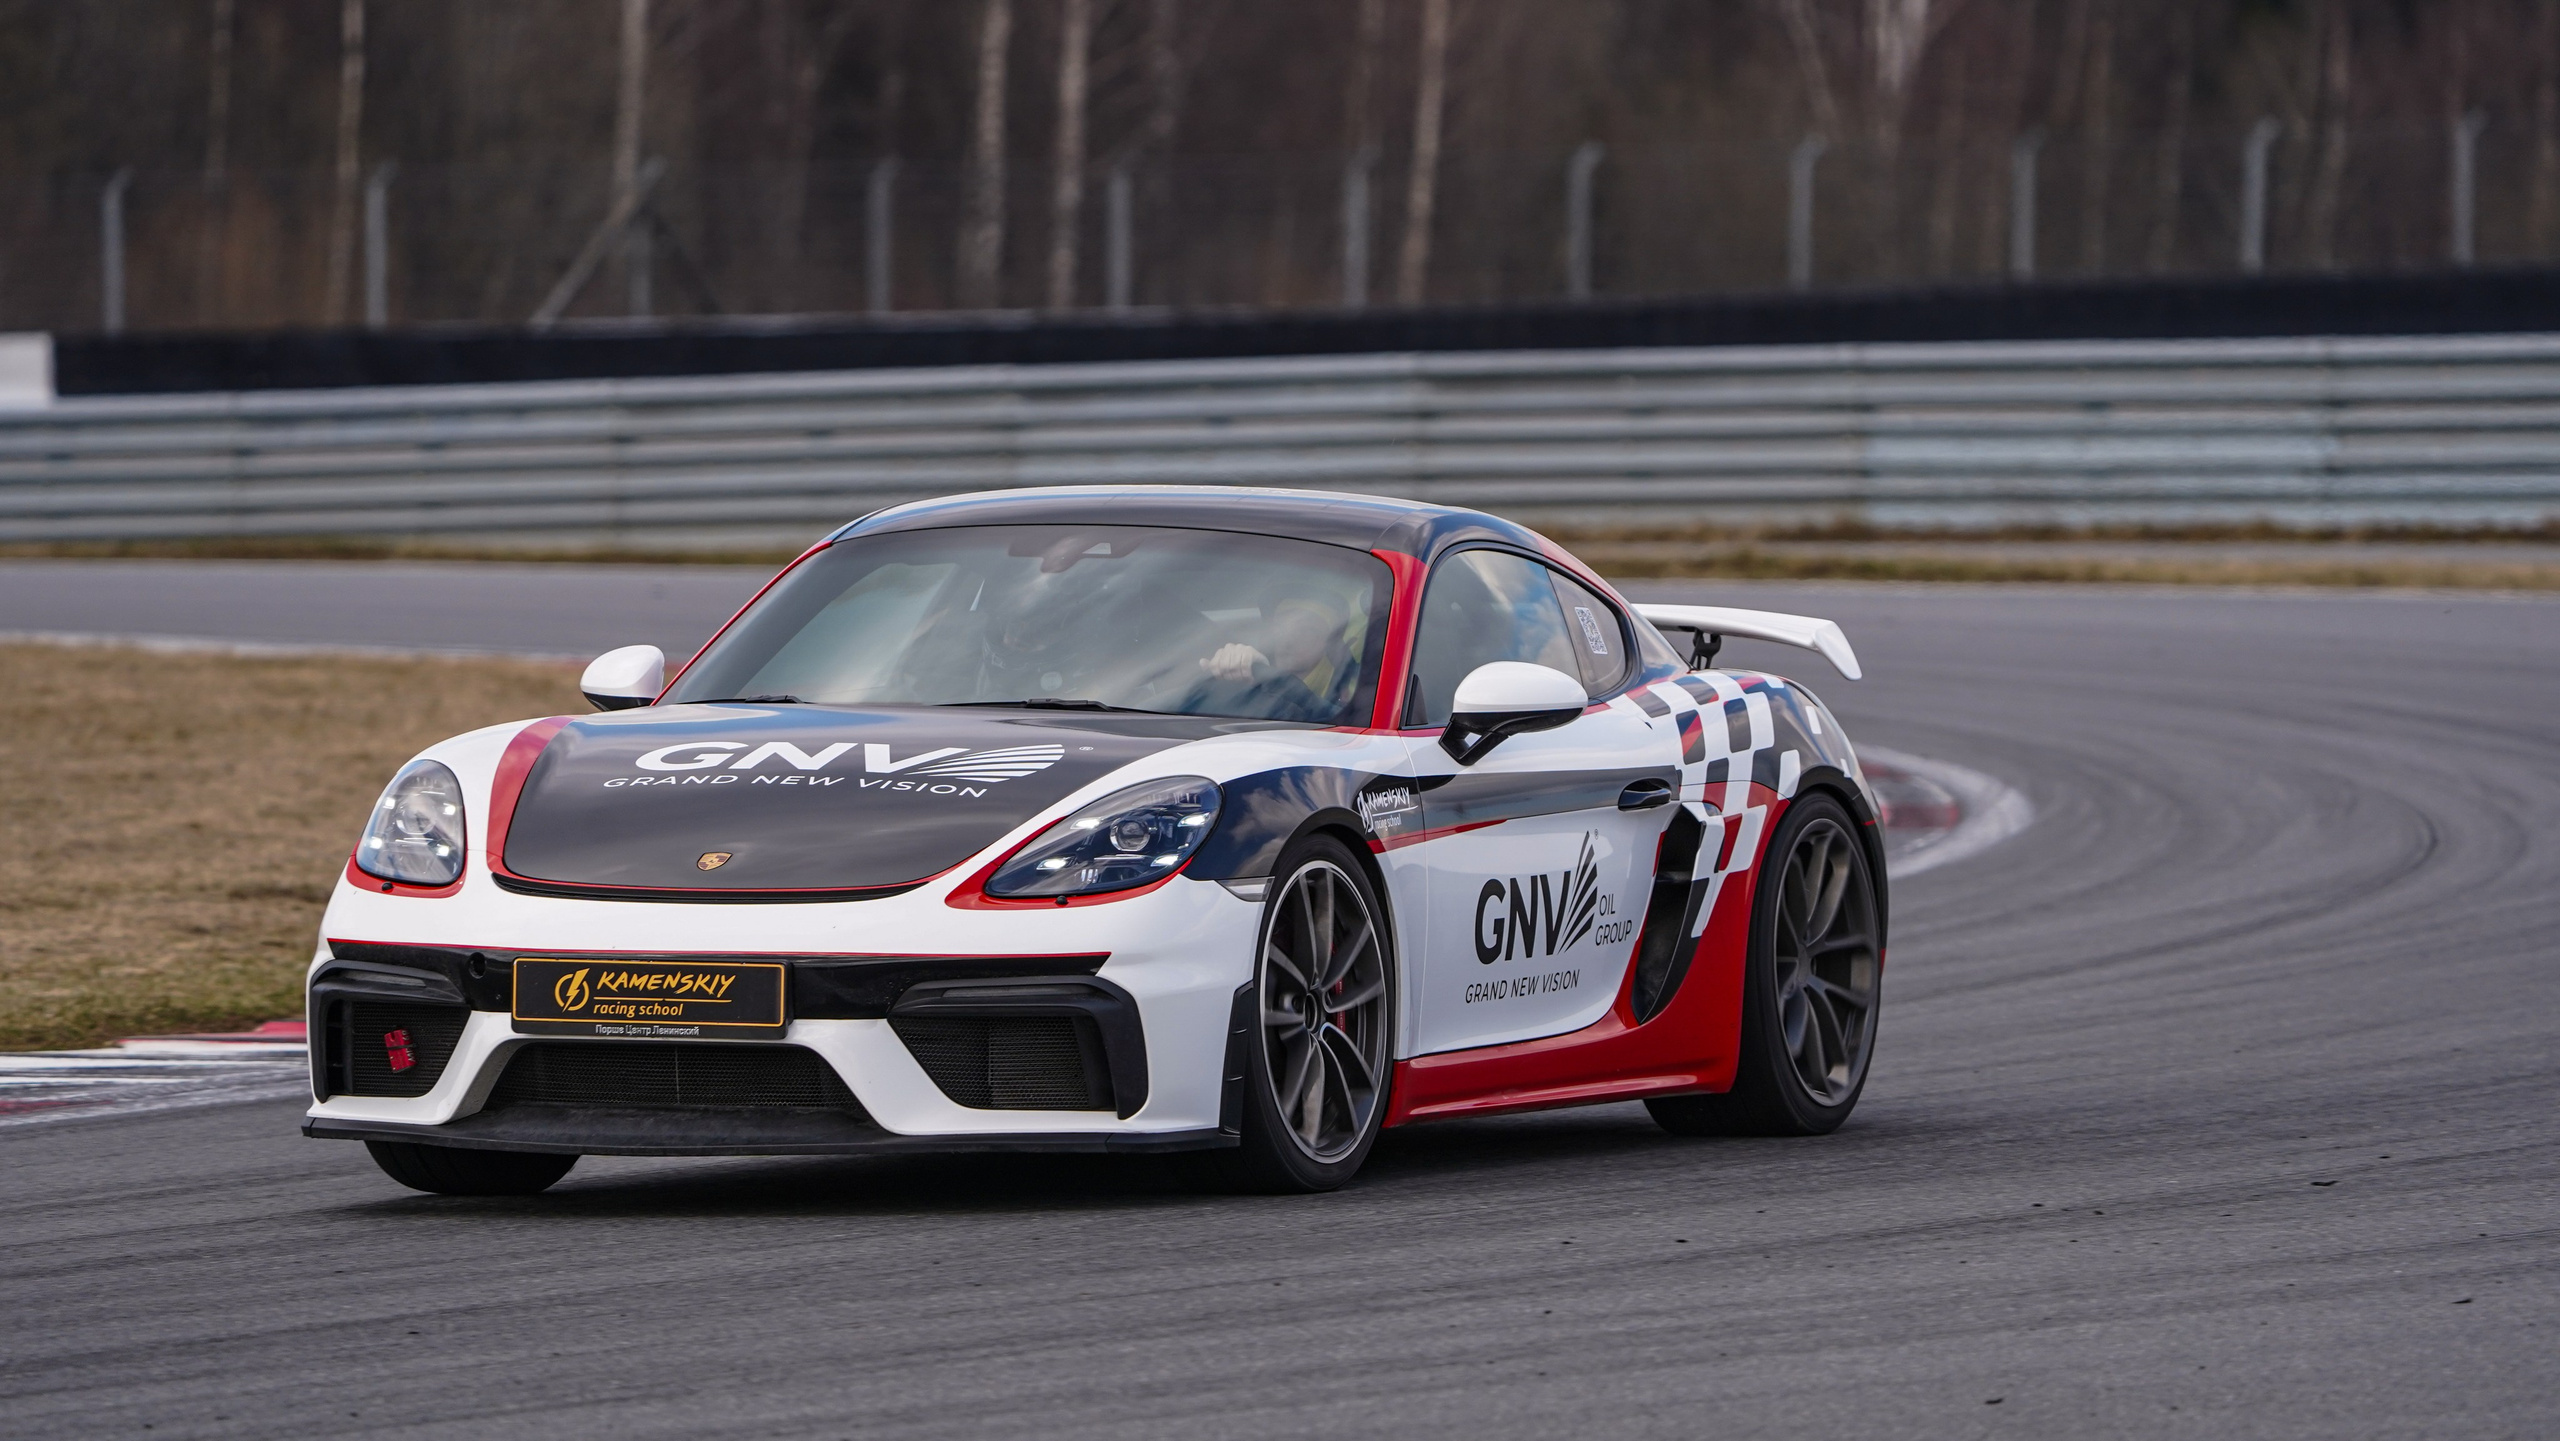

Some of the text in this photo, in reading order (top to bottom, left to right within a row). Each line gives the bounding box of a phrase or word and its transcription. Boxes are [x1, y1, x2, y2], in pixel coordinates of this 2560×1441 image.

[635, 741, 970, 774] GNV
[603, 775, 988, 798] GRAND NEW VISION
[1366, 787, 1410, 810] KAMENSKIY
[1388, 813, 1402, 827] school
[1599, 893, 1616, 917] OIL
[1475, 870, 1571, 965] GNV
[1595, 919, 1632, 947] GROUP
[596, 971, 737, 998] KAMENSKIY
[1465, 968, 1581, 1004] GRAND NEW VISION
[593, 1001, 684, 1018] racing school
[595, 1024, 700, 1036] Порше Центр Ленинский
